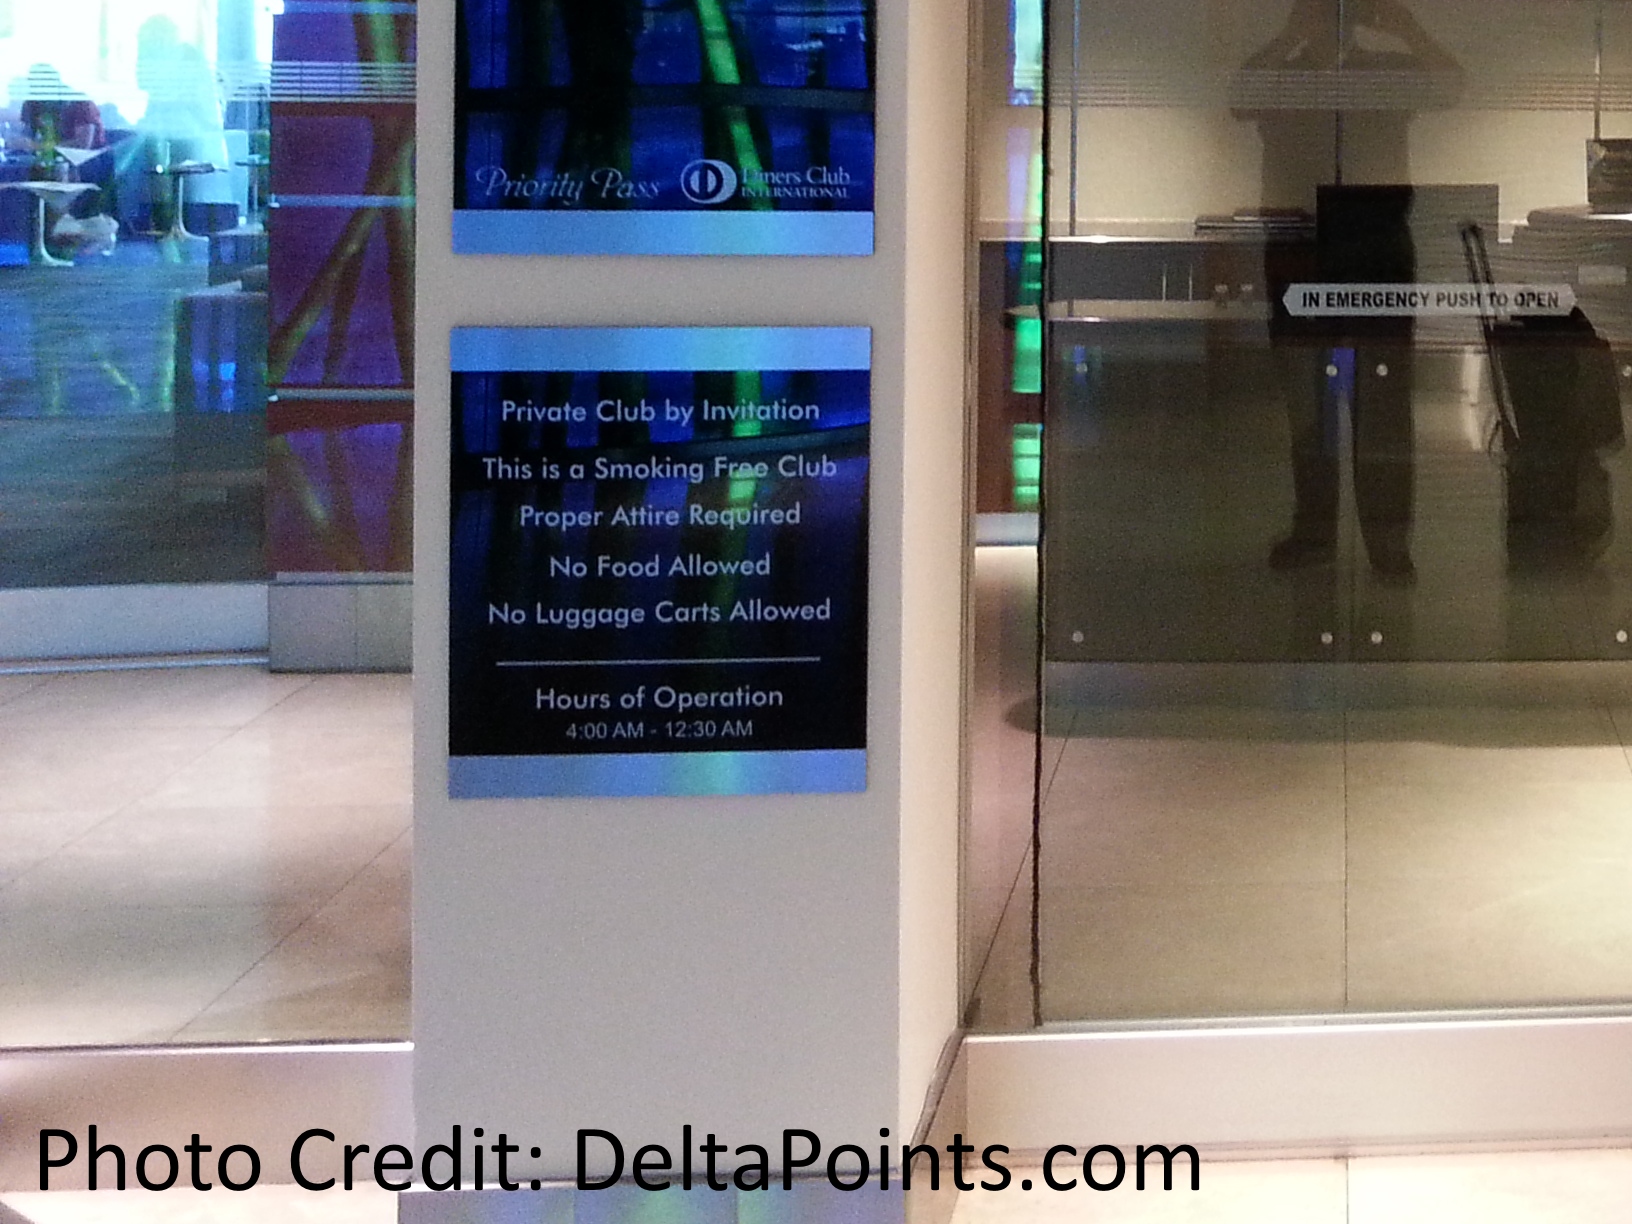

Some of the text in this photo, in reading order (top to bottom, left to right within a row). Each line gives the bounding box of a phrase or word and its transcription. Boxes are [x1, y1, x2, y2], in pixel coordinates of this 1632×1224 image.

[475, 166, 660, 206] Priority Pass
[806, 165, 850, 185] Club
[742, 186, 849, 199] INTERNATIONAL
[1302, 291, 1559, 309] IN EMERGENCY PUSH TO OPEN
[502, 399, 820, 426] Private Club by Invitation
[483, 455, 837, 483] This is a Smoking Free Club
[519, 502, 800, 532] Proper Attire Required
[549, 553, 770, 577] No Food Allowed
[488, 598, 831, 629] No Luggage Carts Allowed
[536, 686, 783, 712] Hours of Operation
[565, 722, 607, 739] 4:00
[612, 722, 645, 739] AM
[664, 721, 717, 738] 12:30
[721, 720, 753, 737] AM
